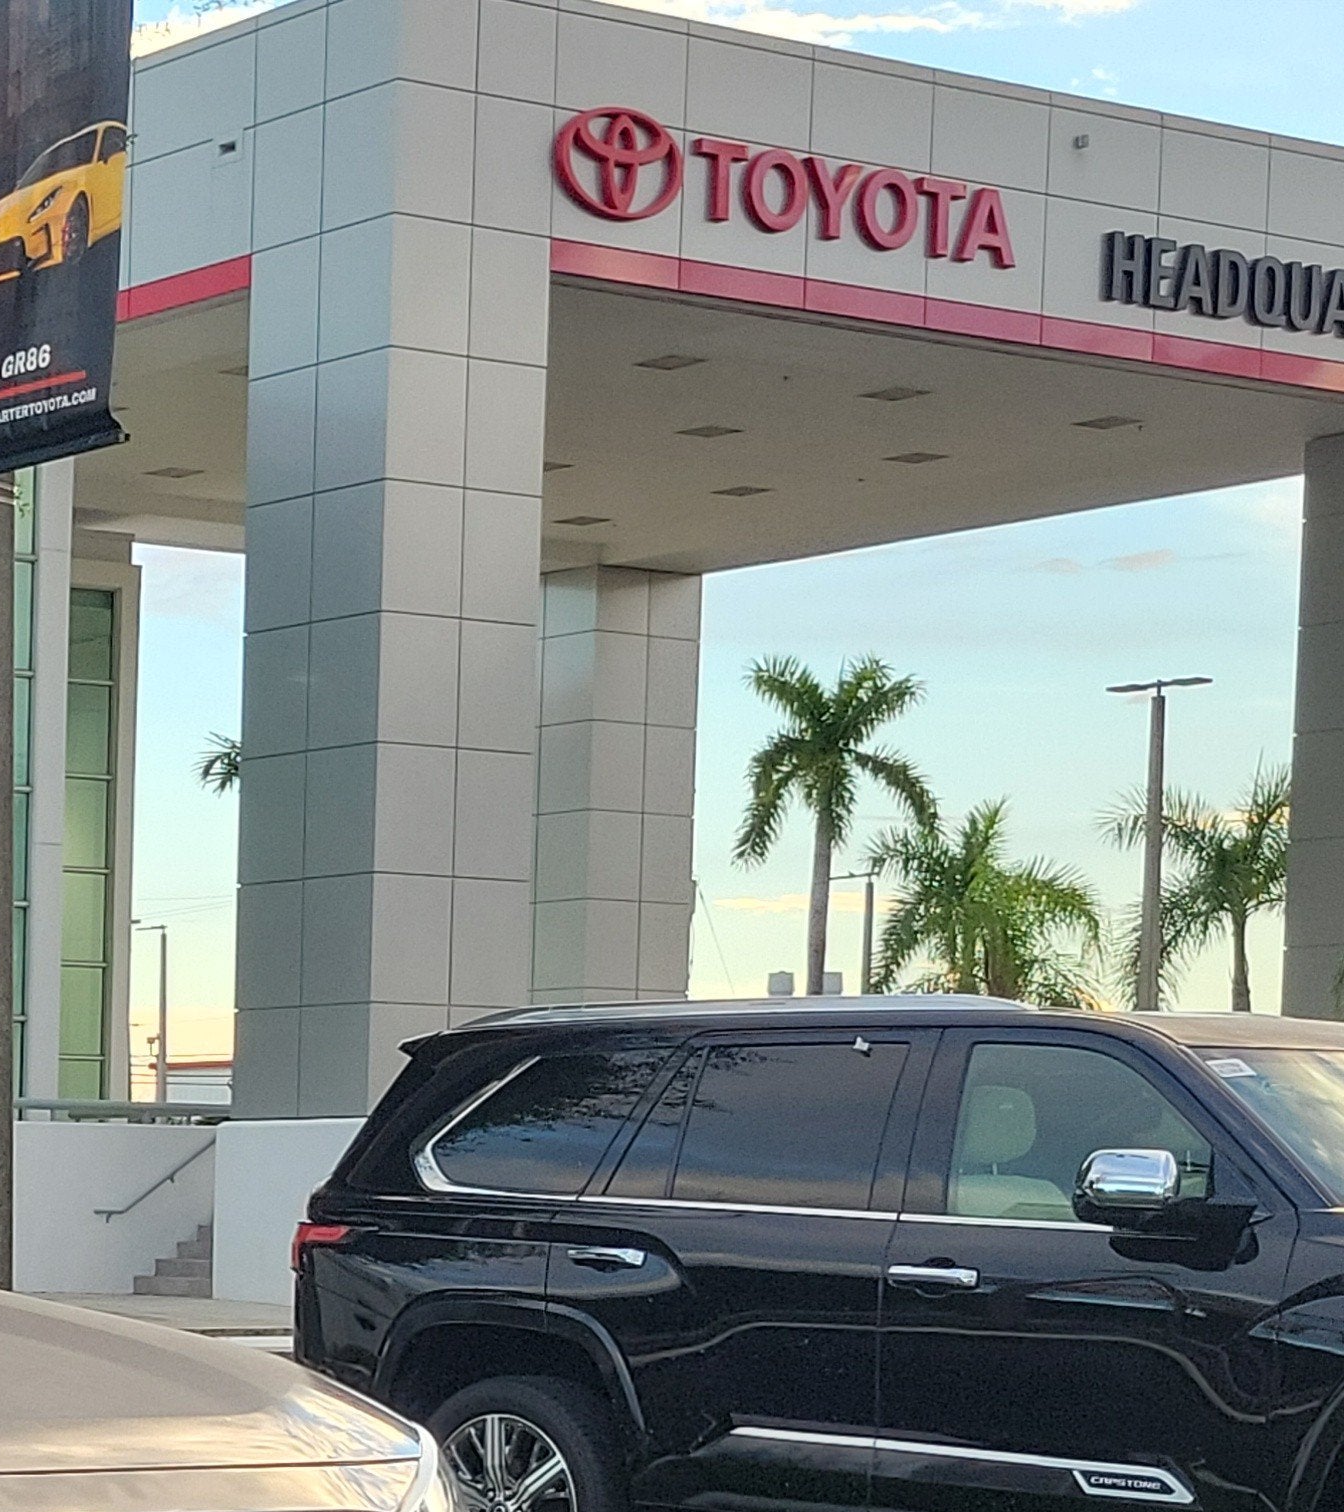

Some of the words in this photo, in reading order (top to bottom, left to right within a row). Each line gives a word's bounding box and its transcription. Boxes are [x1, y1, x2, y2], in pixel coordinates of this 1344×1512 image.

[693, 137, 1016, 269] TOYOTA
[1, 343, 52, 379] GR86
[1089, 1475, 1162, 1490] CAPSTONE
